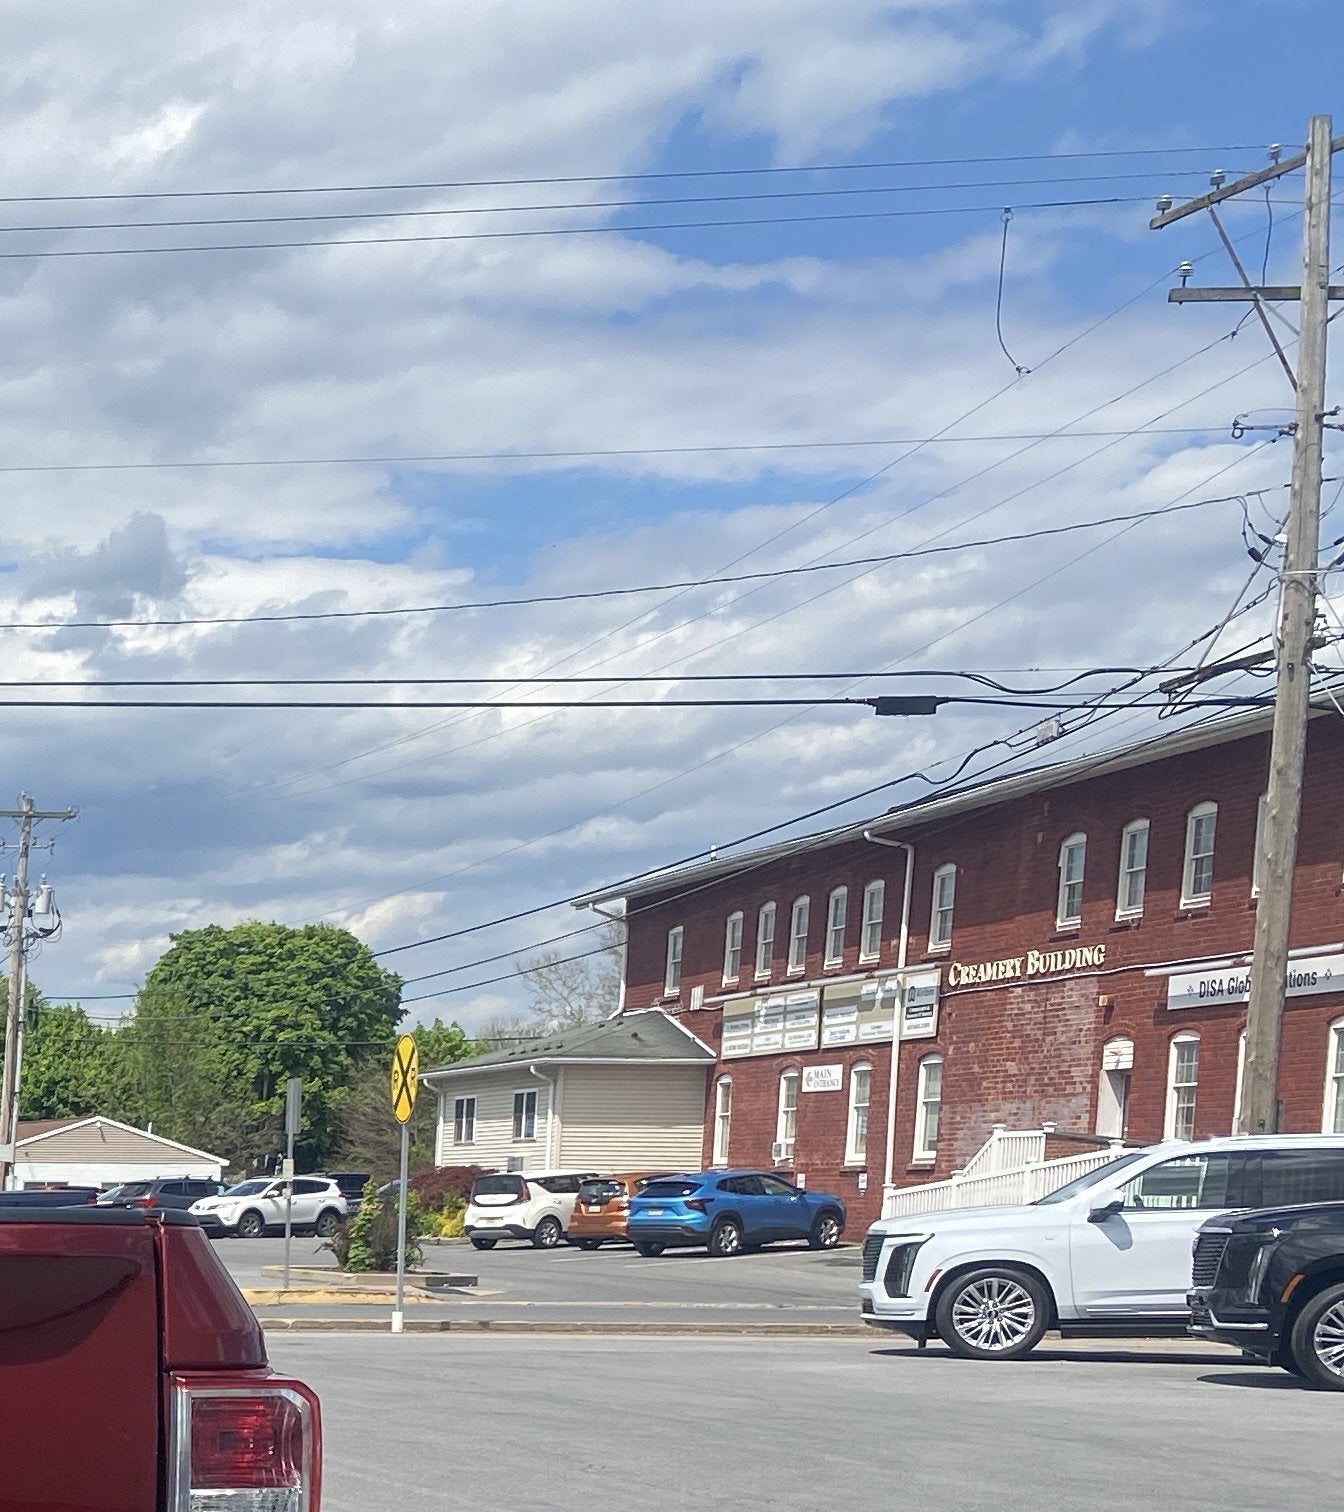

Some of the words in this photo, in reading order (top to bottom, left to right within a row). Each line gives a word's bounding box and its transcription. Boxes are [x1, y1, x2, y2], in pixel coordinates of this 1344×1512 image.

[1199, 979, 1224, 998] DISA
[1227, 975, 1251, 995] Glob
[1288, 969, 1318, 988] tions
